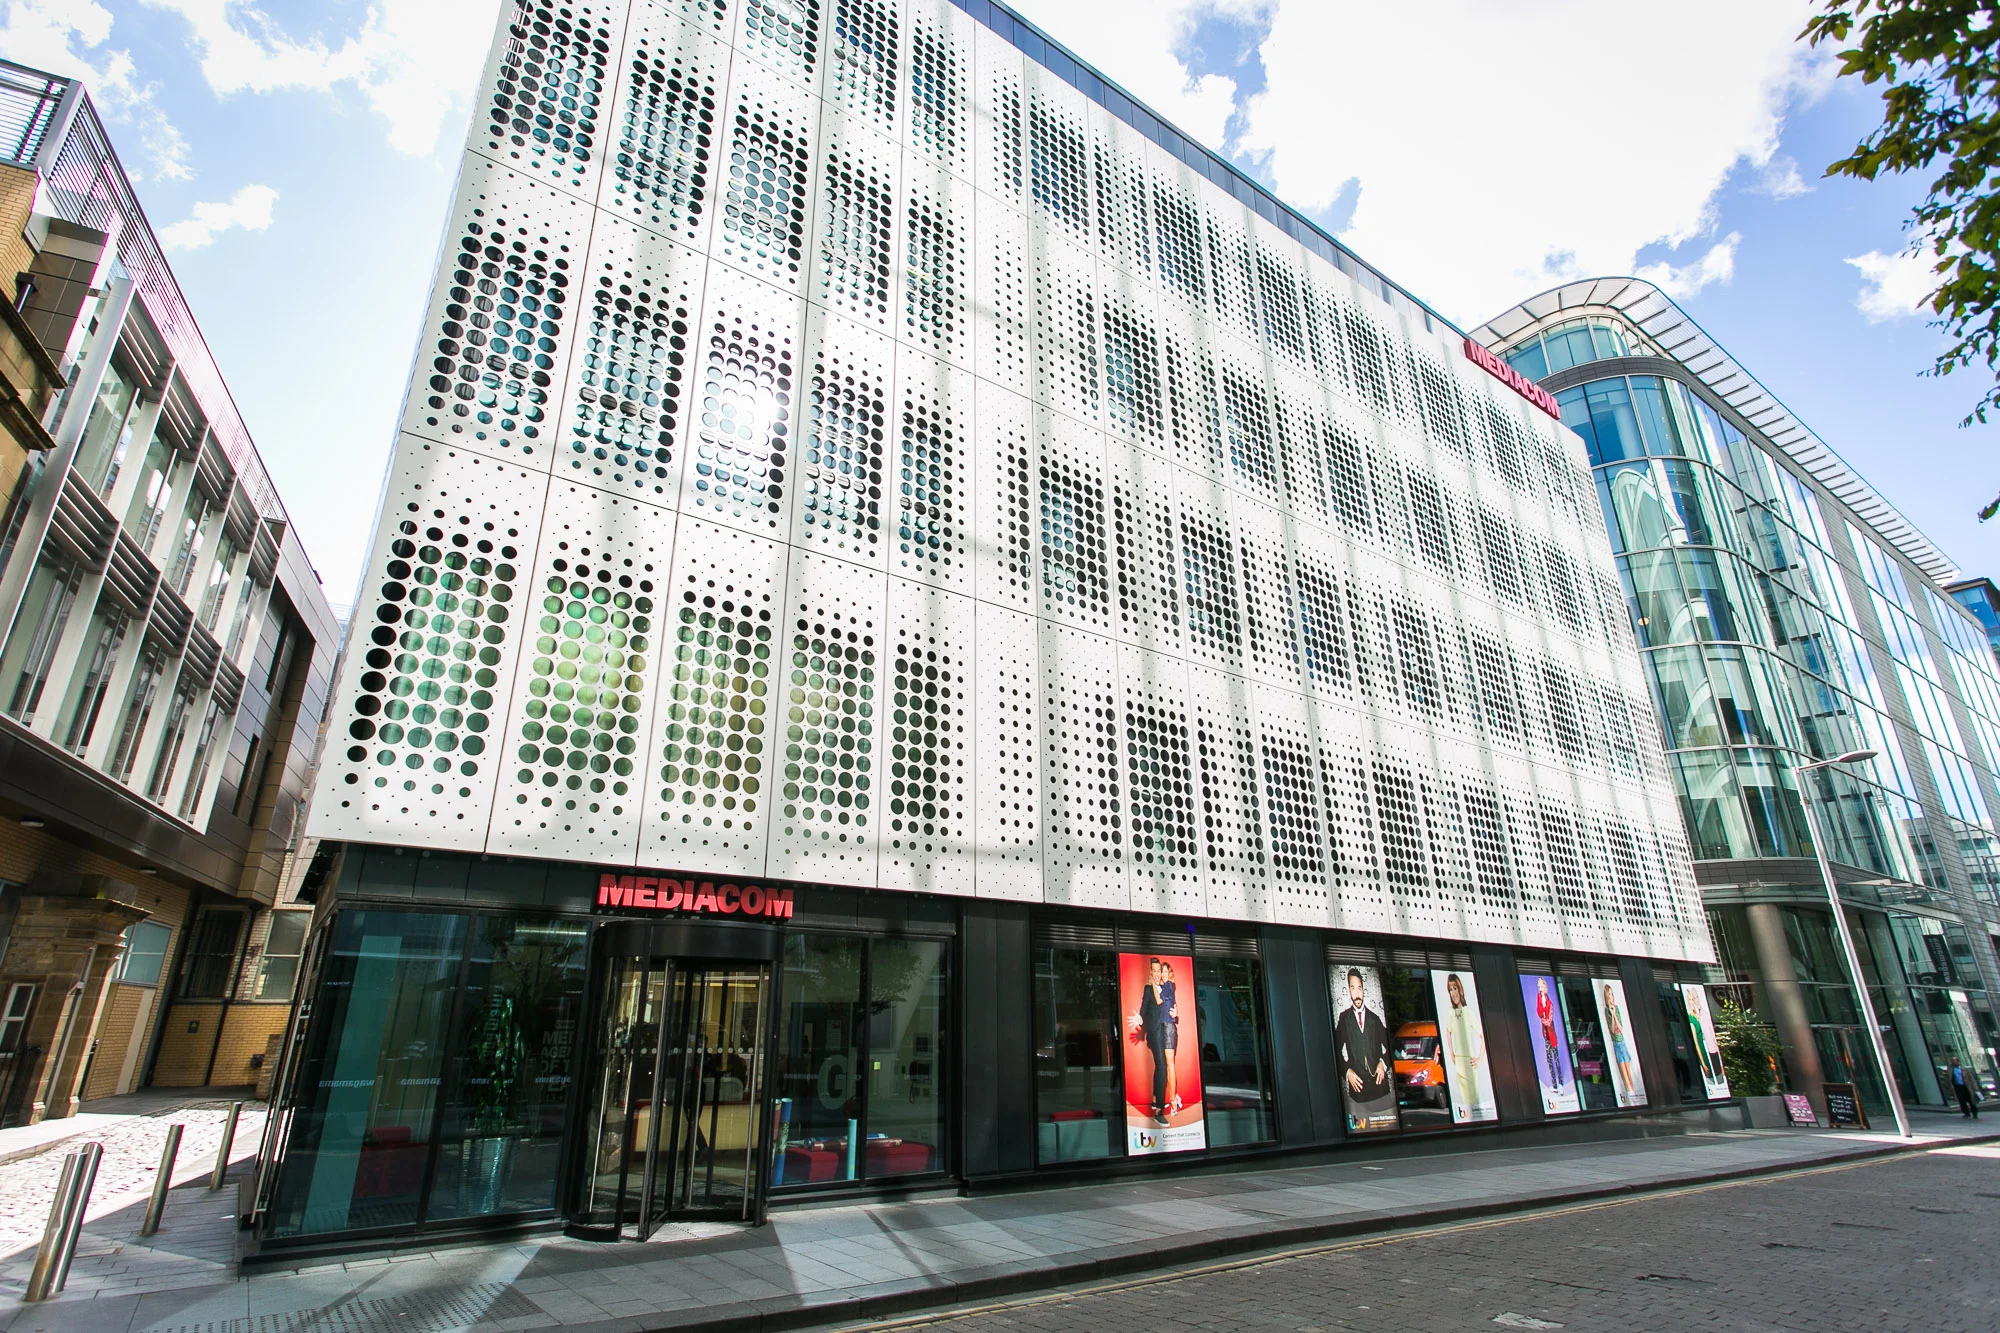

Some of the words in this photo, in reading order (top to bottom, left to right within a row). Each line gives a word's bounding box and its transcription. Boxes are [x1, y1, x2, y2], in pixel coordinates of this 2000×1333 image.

[1464, 339, 1560, 420] MEDIACOM
[598, 873, 793, 918] MEDIACOM
[1348, 1113, 1367, 1130] itv
[1133, 1131, 1157, 1149] itv
